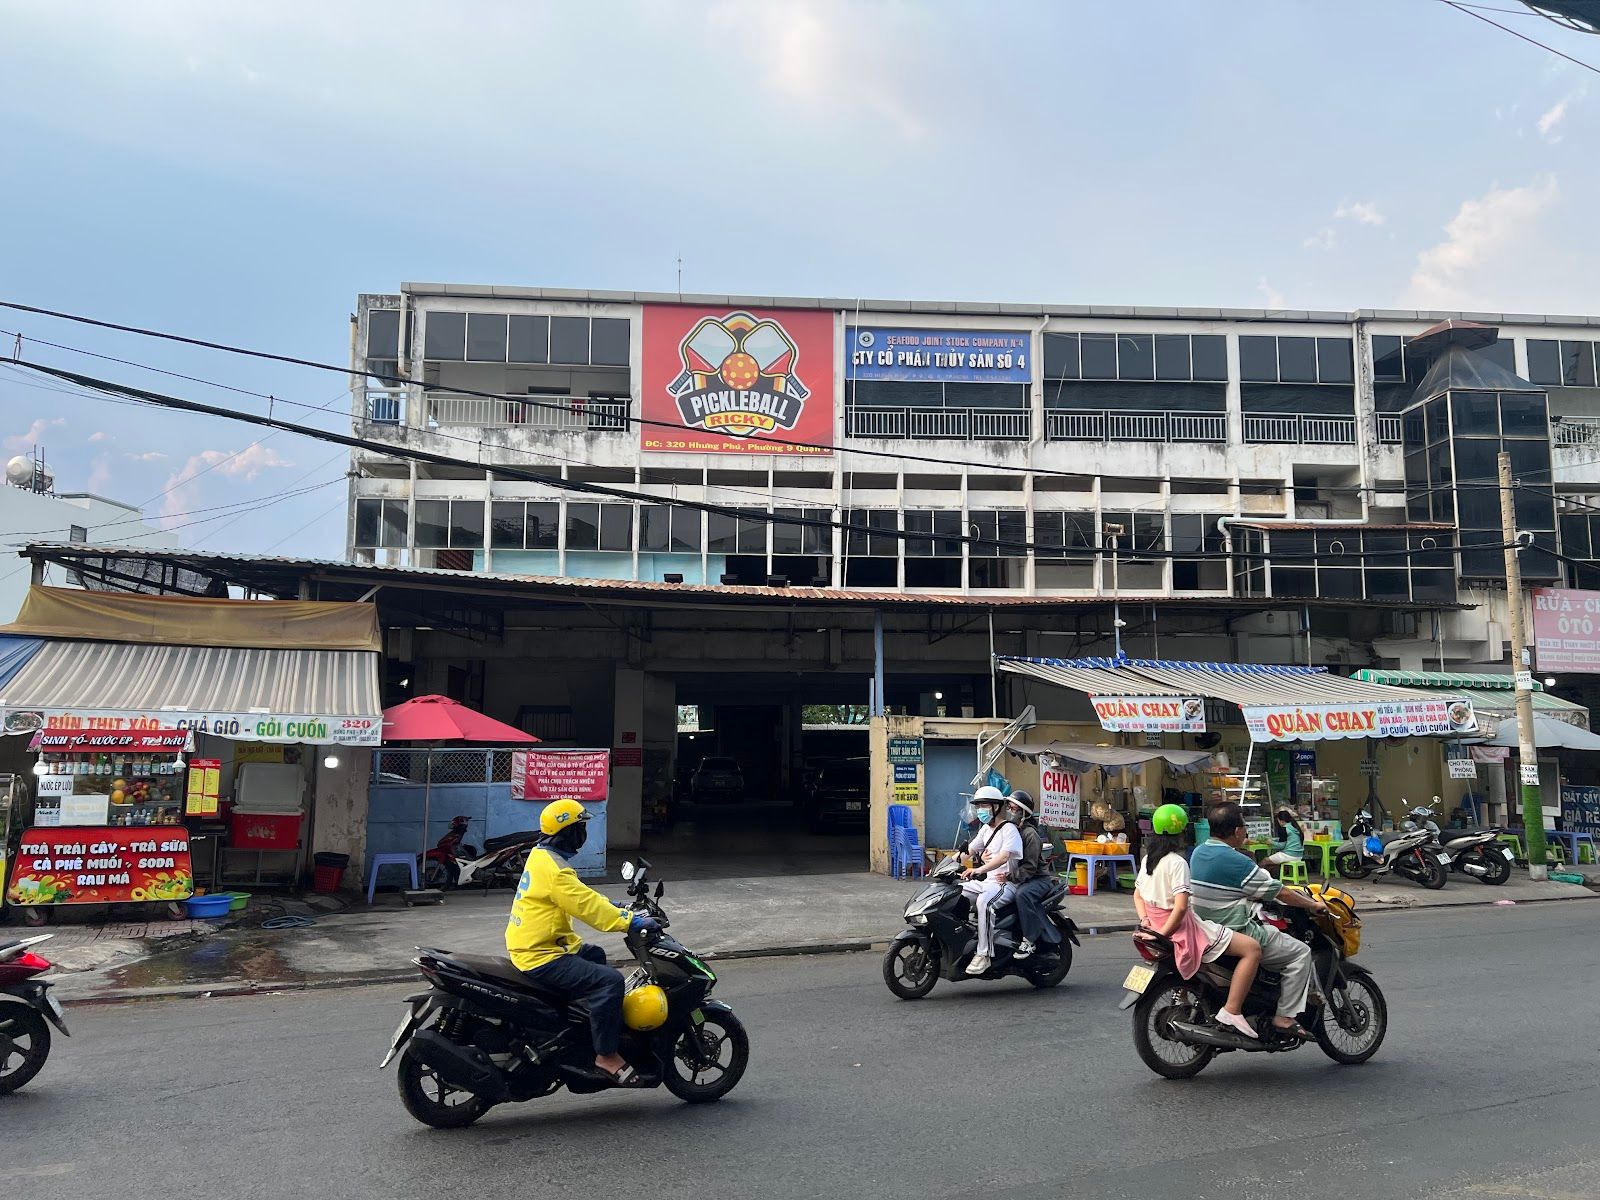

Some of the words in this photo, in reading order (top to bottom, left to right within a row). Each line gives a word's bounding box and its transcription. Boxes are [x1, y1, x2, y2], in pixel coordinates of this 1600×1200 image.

[887, 336, 920, 346] SEAFOOD
[922, 336, 944, 346] JOINT
[946, 337, 970, 346] STOCK
[972, 337, 1008, 348] COMPANY
[969, 349, 994, 368] SẢN
[997, 350, 1013, 368] SỐ
[1018, 354, 1026, 368] 4
[690, 390, 789, 420] PICKLEBALL
[710, 414, 770, 426] RICKY
[1535, 590, 1572, 612] RỬA
[1558, 613, 1593, 635] ÔTÔ
[1141, 703, 1180, 717] CHAY
[214, 717, 240, 735] GIÒ
[256, 717, 282, 736] GỎI
[286, 717, 328, 738] CUỐN
[341, 720, 371, 728] 320
[1326, 711, 1375, 730] CHAY
[1390, 725, 1408, 734] CUỐN
[1416, 723, 1427, 732] GỎI
[1429, 722, 1449, 732] CUỐN
[42, 735, 68, 745] SINH
[89, 734, 117, 745] NƯỚC
[119, 734, 133, 745] ÉP
[1042, 771, 1078, 794] CHAY
[21, 842, 48, 855] TRÀ
[54, 842, 86, 855] TRÁI
[90, 841, 118, 854] CÂY
[130, 840, 156, 852] TRÀ
[160, 840, 188, 852] SỮA
[32, 857, 51, 870] CÀ
[55, 857, 83, 870] PHÊ
[87, 854, 122, 869] MUỐI
[138, 857, 174, 868] SODA
[77, 874, 105, 886] RAU
[108, 871, 130, 885] MÁ
[648, 947, 680, 959] 160
